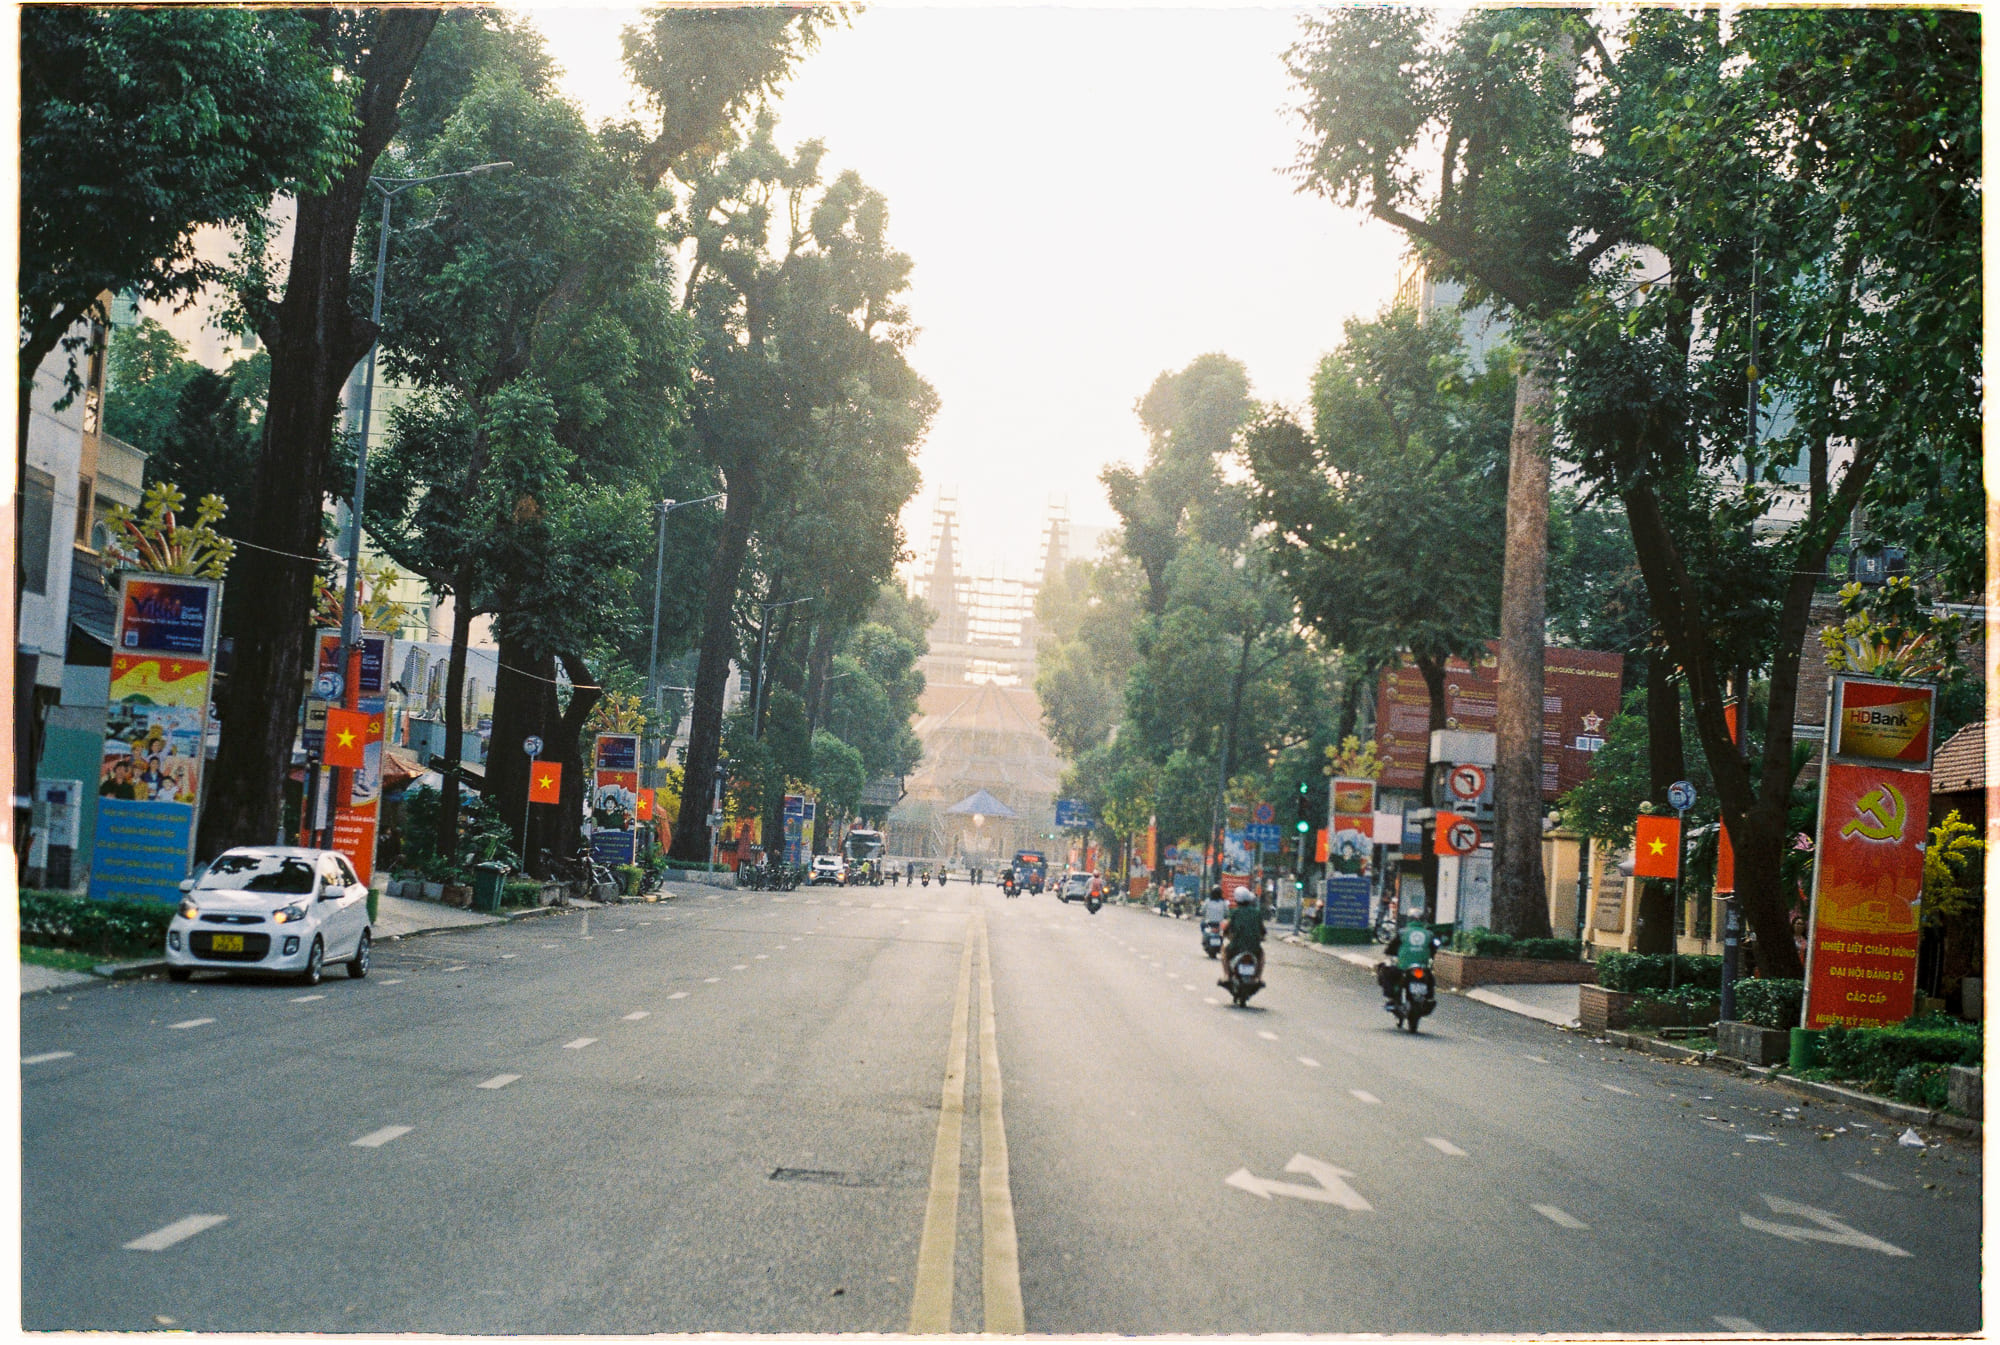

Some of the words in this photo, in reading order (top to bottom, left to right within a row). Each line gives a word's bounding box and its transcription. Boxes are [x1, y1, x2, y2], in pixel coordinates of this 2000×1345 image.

[1850, 711, 1908, 727] HDBank
[1821, 940, 1846, 953] NHIỆT
[1846, 942, 1863, 955] LIỆT
[1864, 944, 1890, 956] CHÀO
[1892, 945, 1916, 958] MỪNG
[1829, 966, 1846, 978] ĐẠI
[1848, 966, 1865, 980] HỘI
[1866, 968, 1891, 981] ĐẢNG
[1892, 970, 1904, 984] BỘ
[1846, 990, 1867, 1003] CÁC
[1868, 991, 1887, 1004] CẤP
